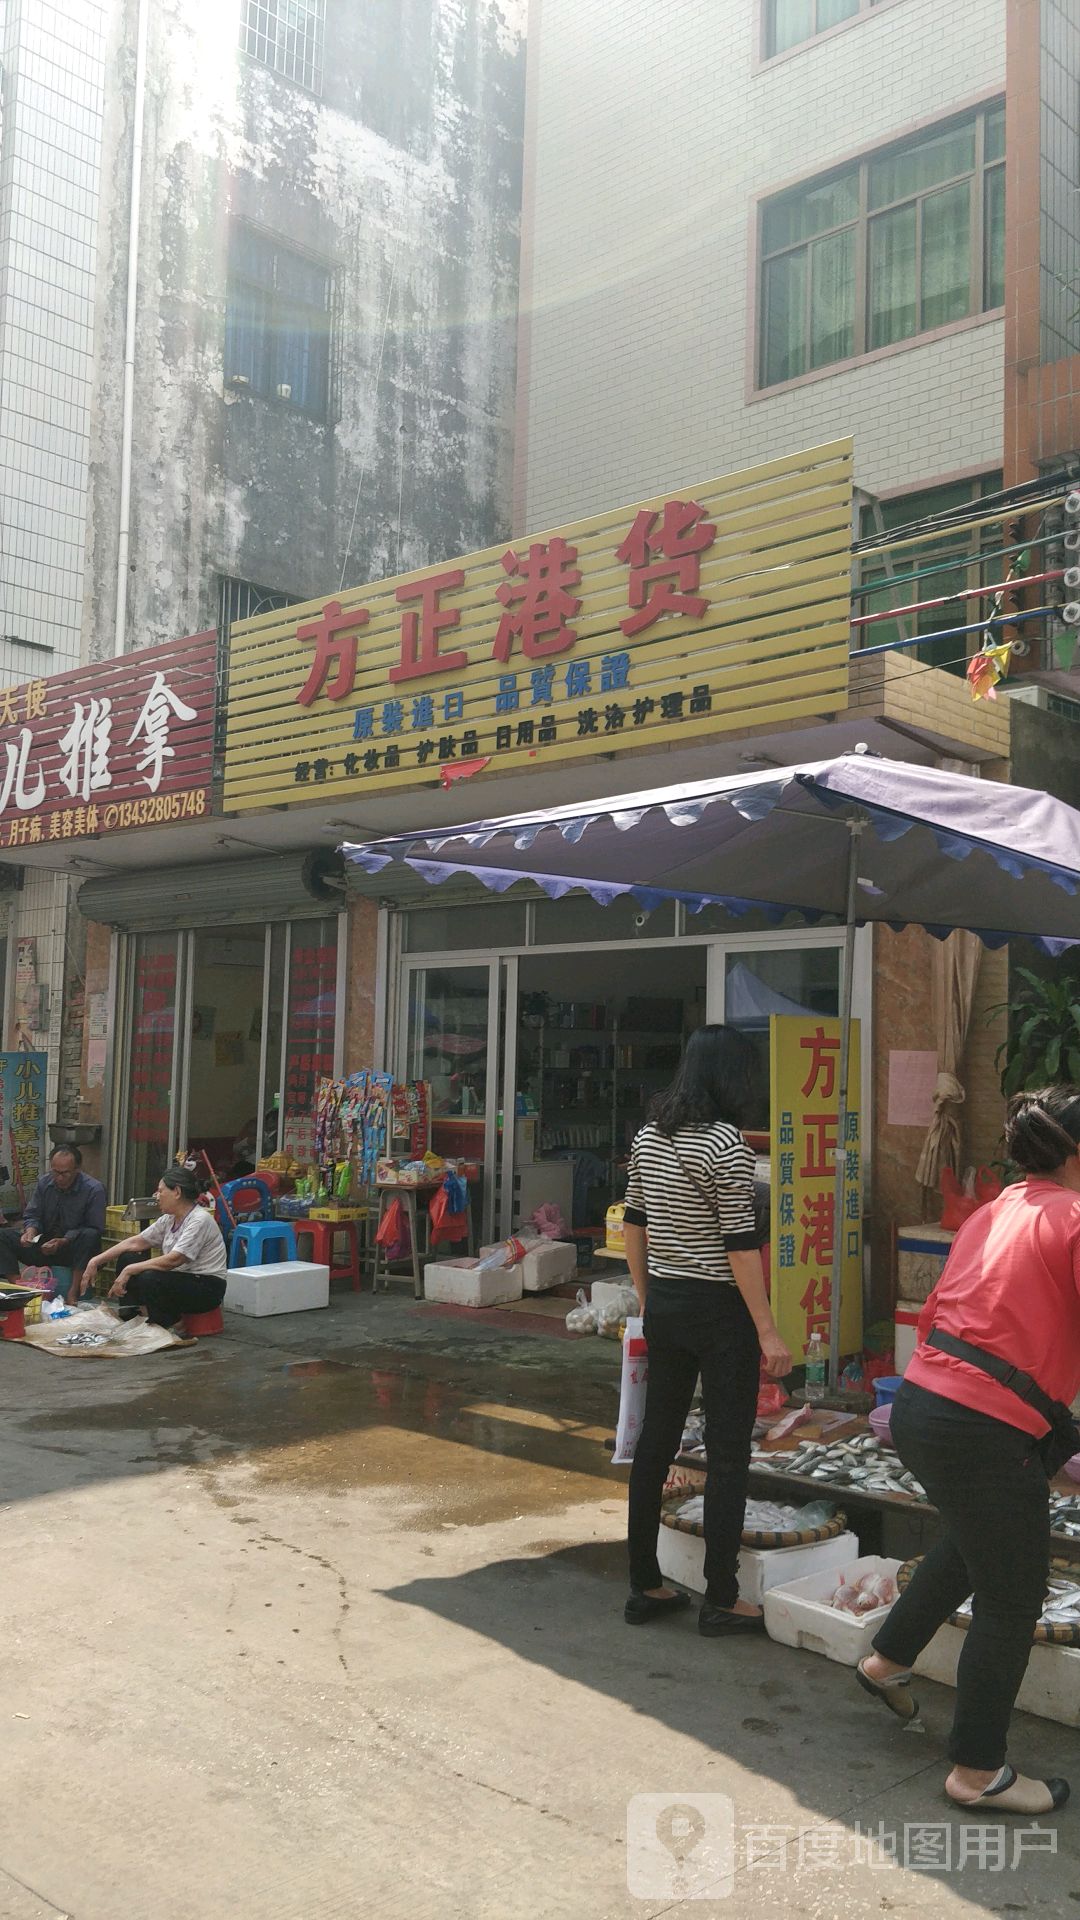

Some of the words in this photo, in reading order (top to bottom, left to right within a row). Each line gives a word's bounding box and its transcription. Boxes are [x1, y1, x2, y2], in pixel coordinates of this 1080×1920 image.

[296, 500, 717, 707] 方正港货
[353, 691, 464, 739] 原裝進口
[495, 652, 632, 714] 品質保證
[496, 715, 557, 750] 日用品
[118, 789, 206, 827] 13432805748
[779, 1111, 796, 1269] 品質保證
